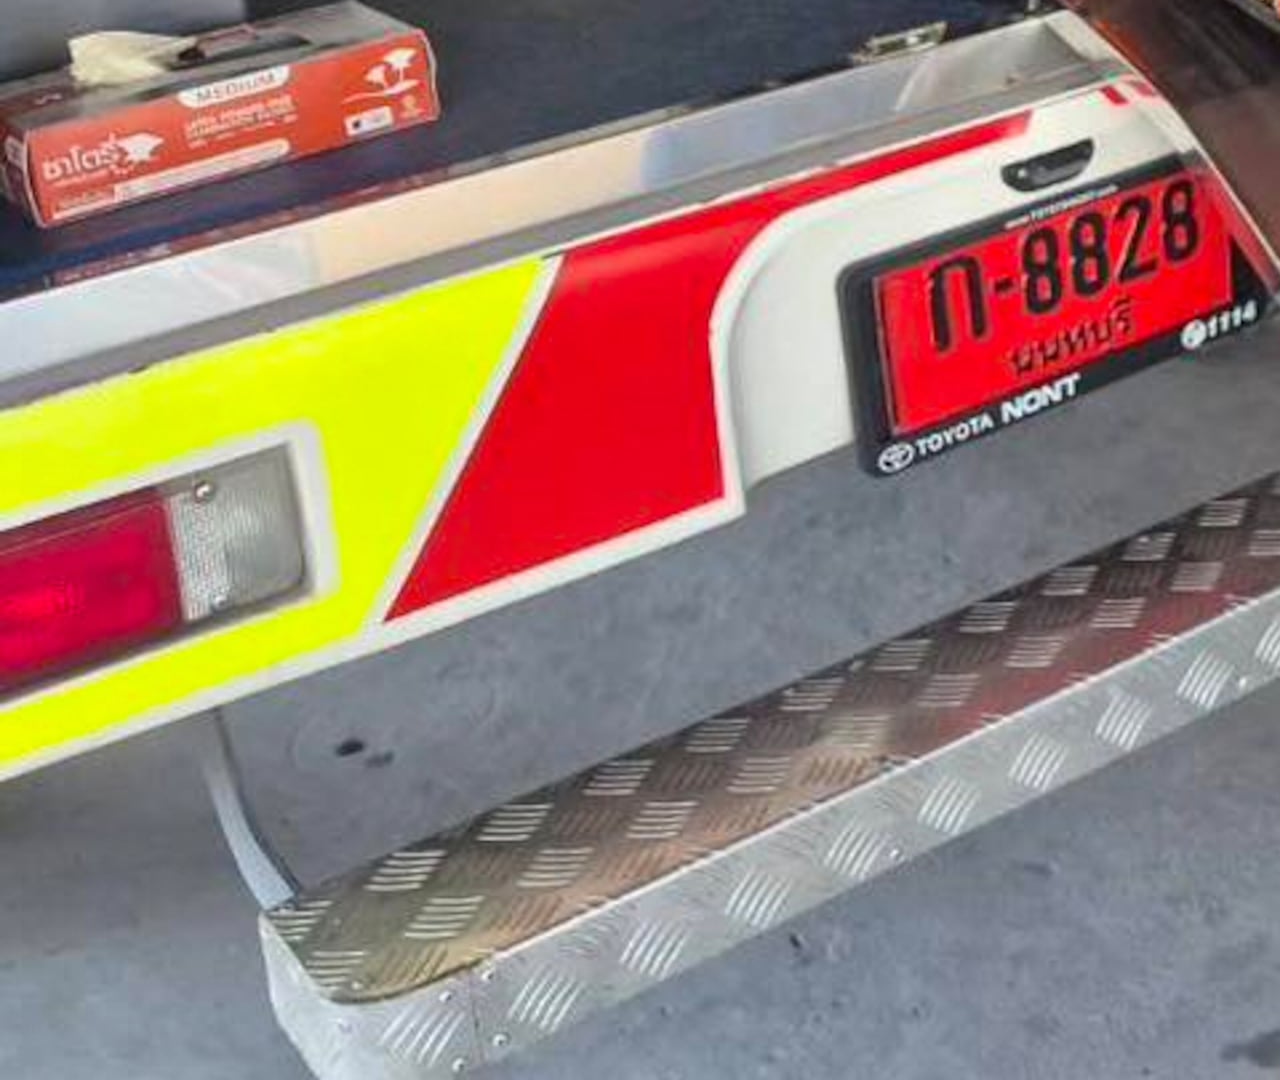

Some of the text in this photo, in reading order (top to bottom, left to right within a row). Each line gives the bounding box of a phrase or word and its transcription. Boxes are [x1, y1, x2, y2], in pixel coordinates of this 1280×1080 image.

[927, 178, 1199, 354] ก-8828
[915, 372, 1081, 456] TOYOTA NONT
